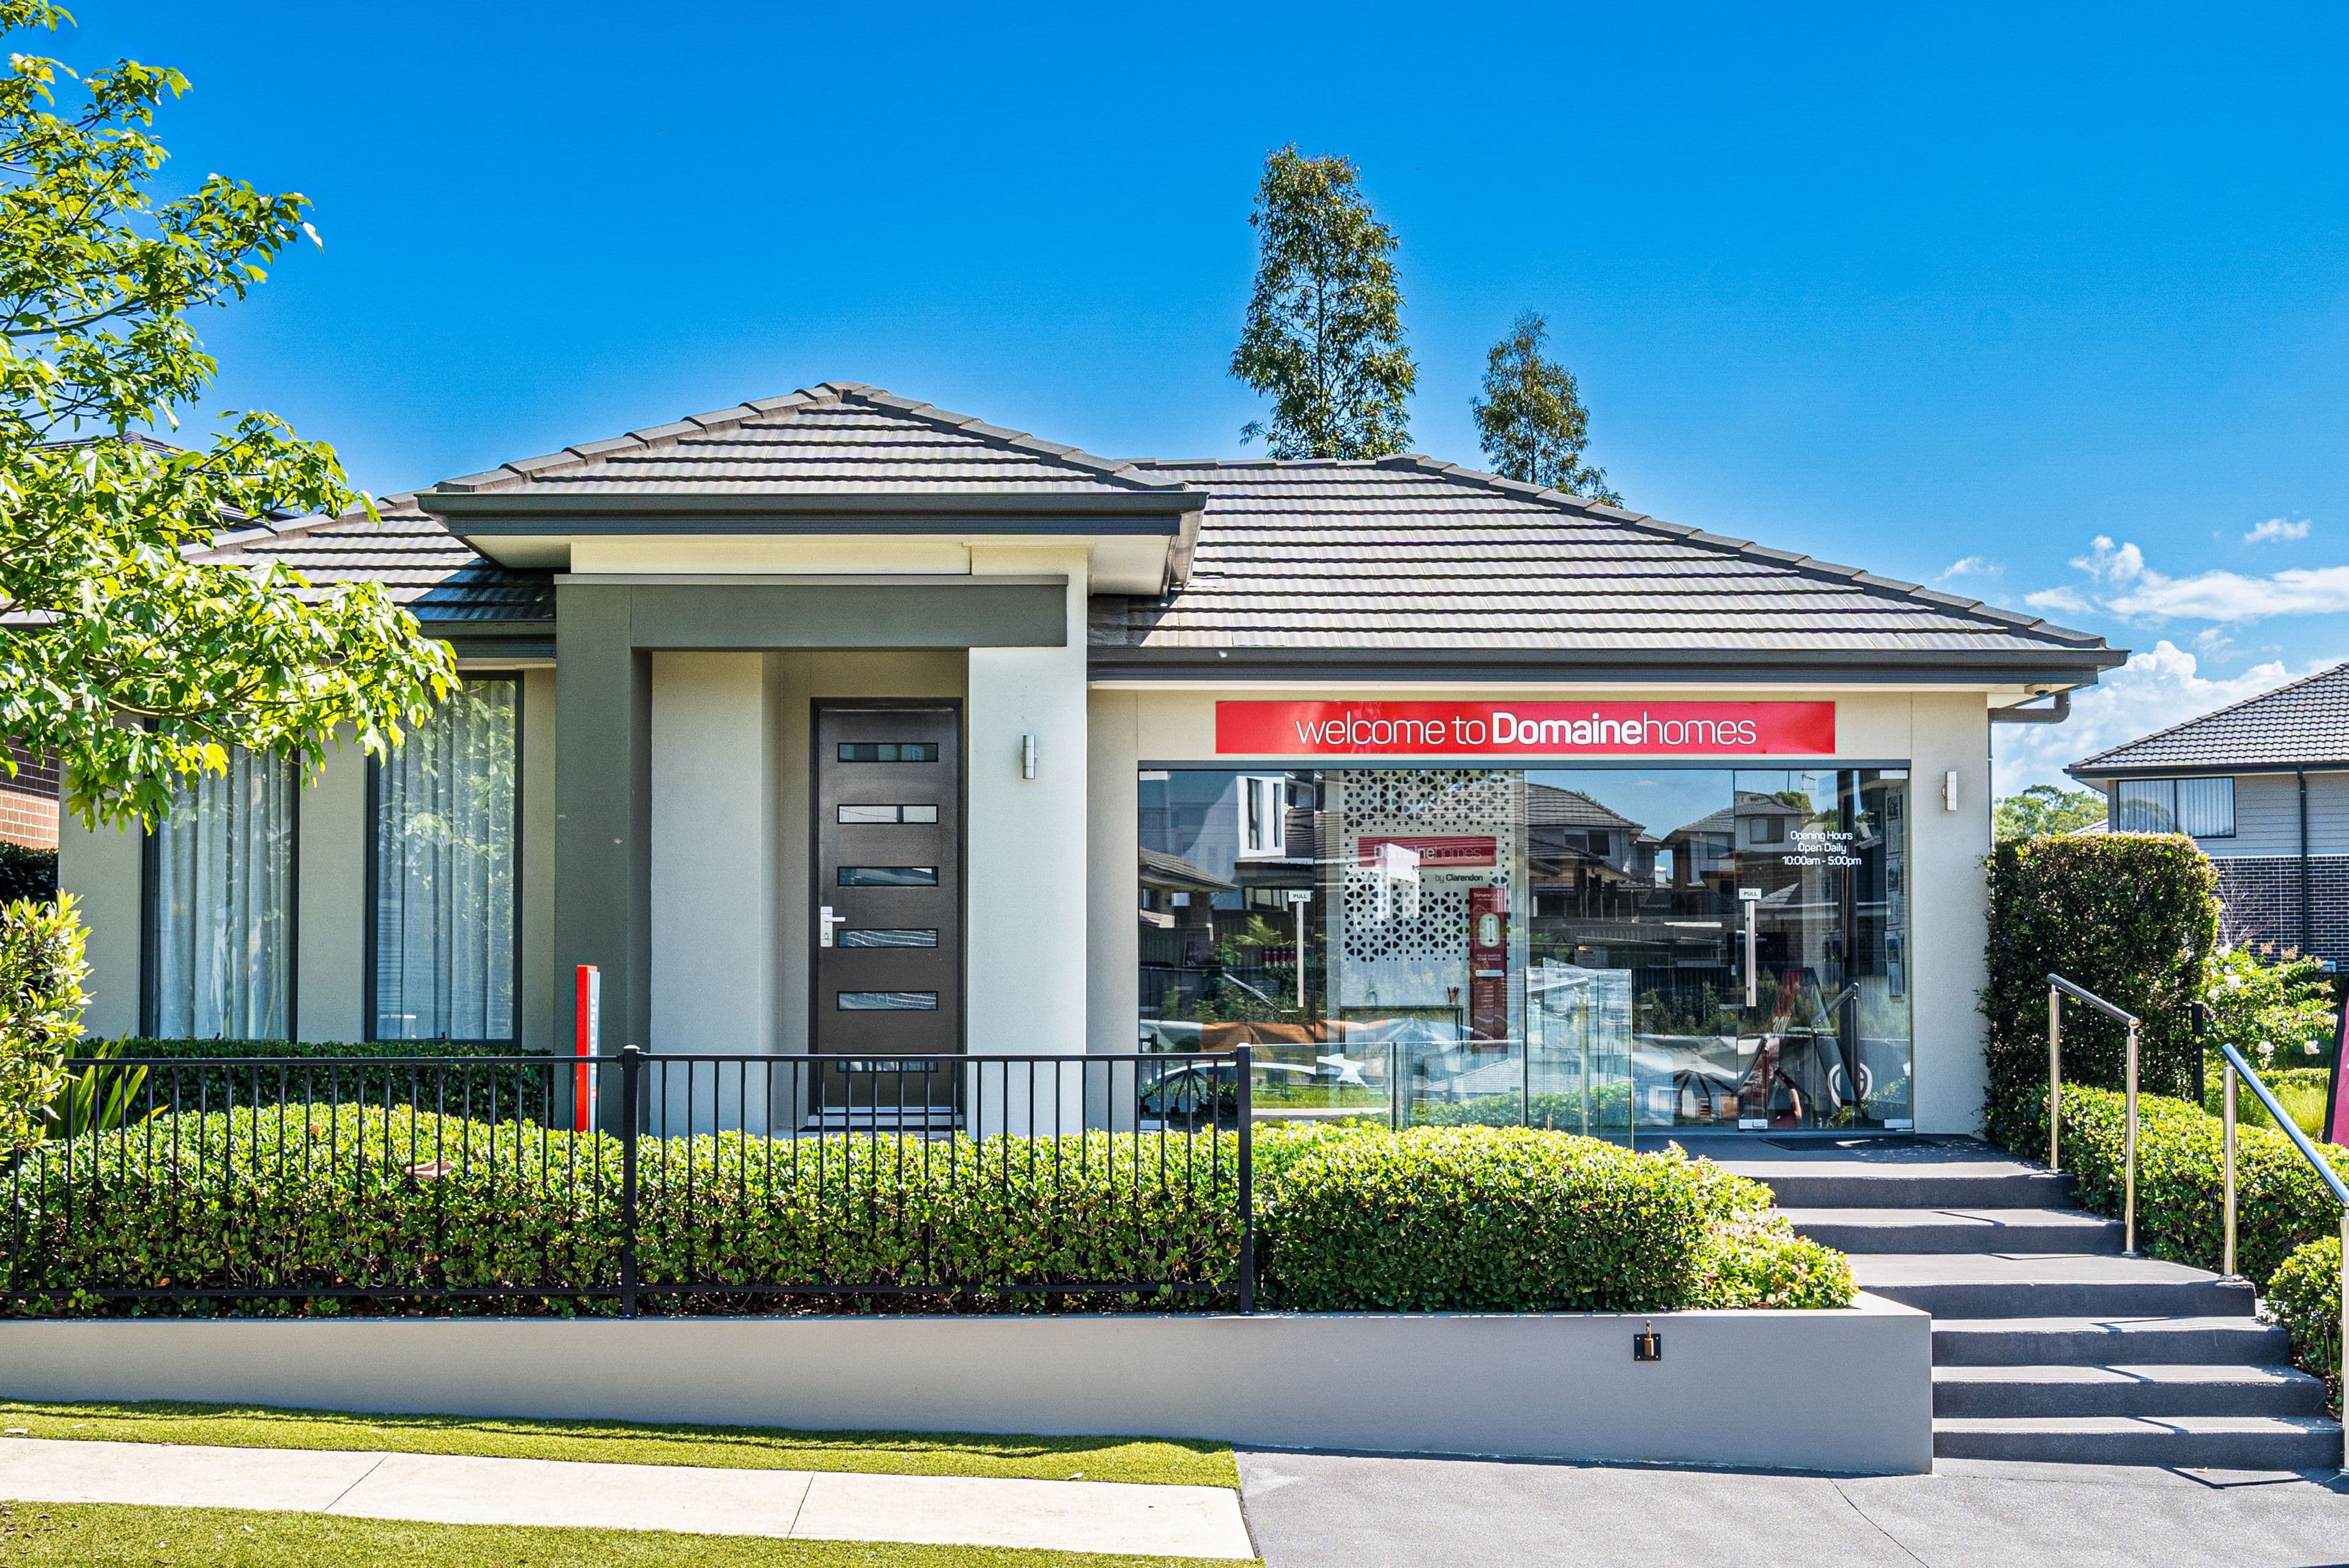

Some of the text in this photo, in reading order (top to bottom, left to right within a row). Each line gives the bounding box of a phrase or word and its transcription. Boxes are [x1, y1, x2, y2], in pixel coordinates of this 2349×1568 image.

[1296, 711, 1757, 745] welcome to Domainehomes
[1790, 830, 1853, 842] Opening Hours
[1374, 845, 1482, 859] Dnehomes
[1798, 843, 1847, 854] Open Daily
[1782, 856, 1820, 865] 10:00am
[1827, 856, 1862, 867] 5:00pm
